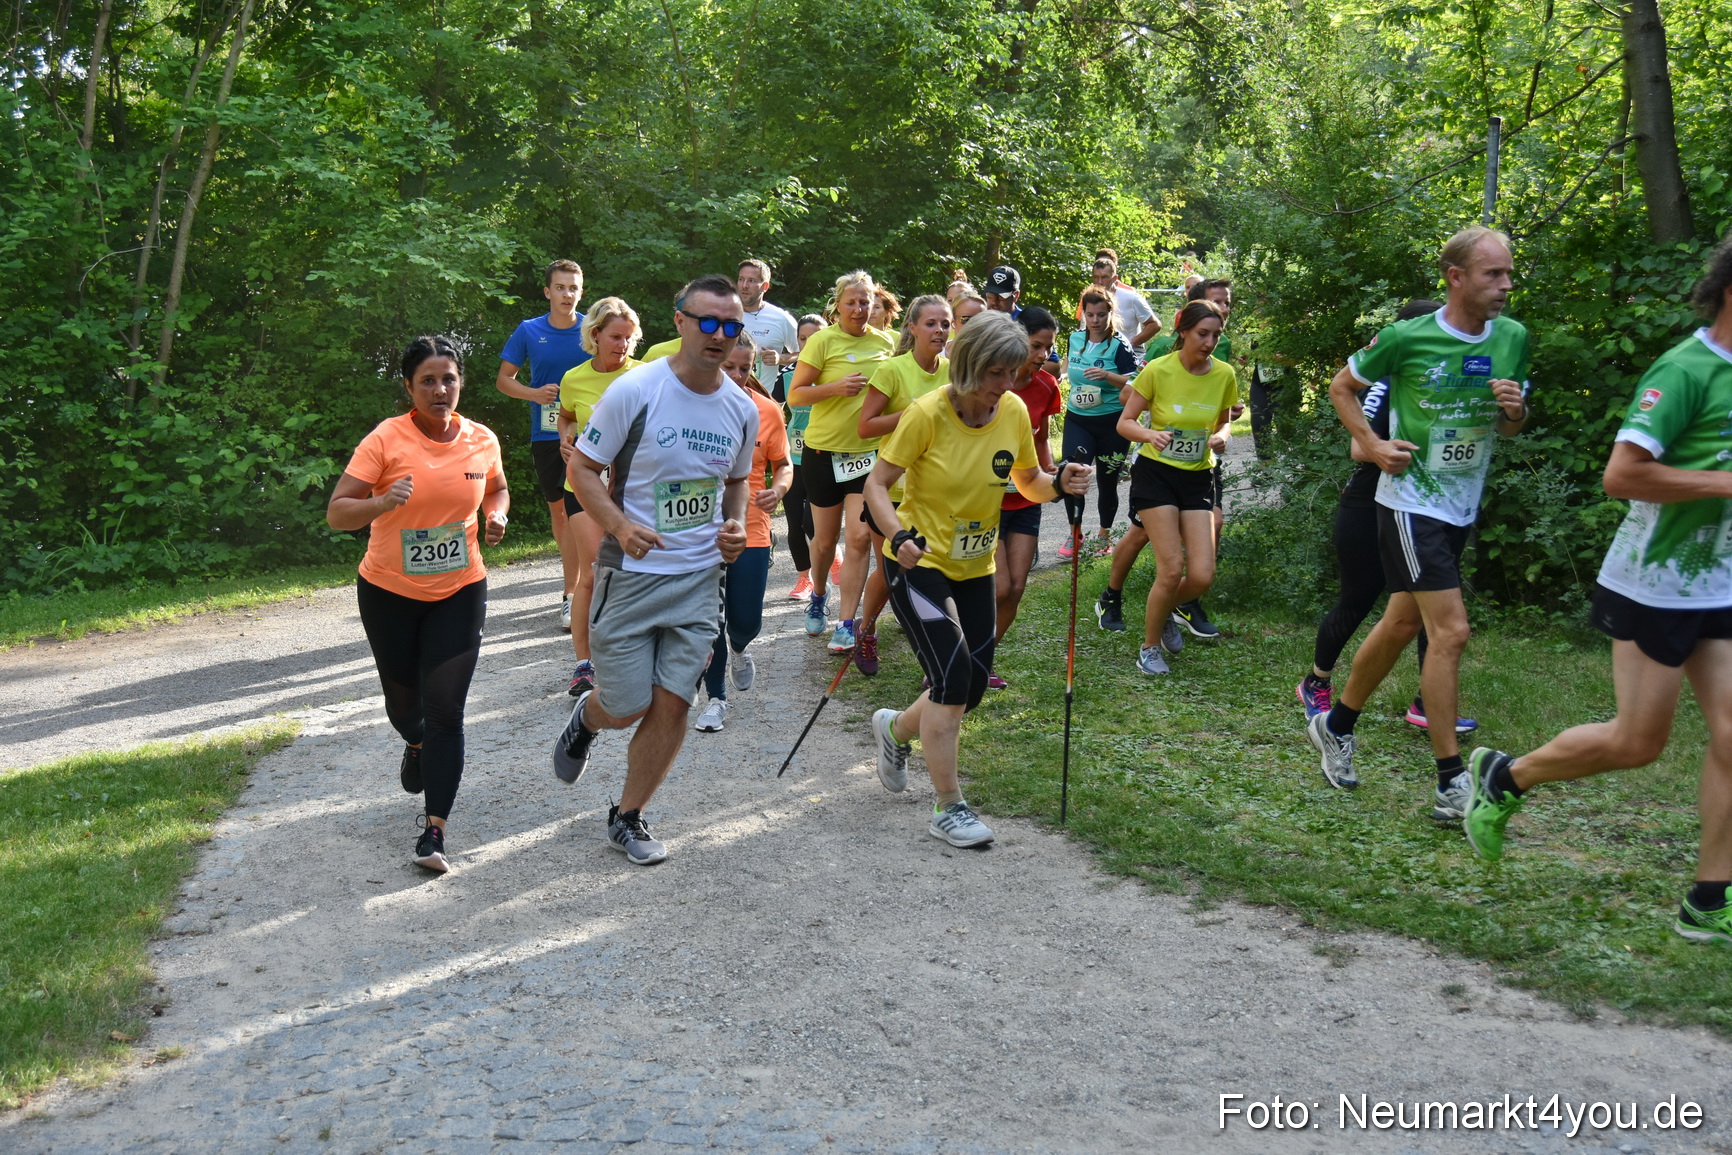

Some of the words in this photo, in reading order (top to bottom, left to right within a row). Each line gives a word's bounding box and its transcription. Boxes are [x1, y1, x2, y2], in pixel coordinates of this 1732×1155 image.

[1076, 393, 1094, 404] 970
[1419, 398, 1465, 410] Gesunde
[1439, 409, 1472, 420] laufen
[681, 427, 733, 448] HAUBNER
[1169, 439, 1200, 453] 1231
[687, 440, 727, 457] TREPPEN
[1441, 443, 1476, 462] 566
[839, 458, 871, 474] 1209
[664, 495, 710, 518] 1003
[960, 527, 996, 550] 1769
[410, 539, 460, 562] 2302
